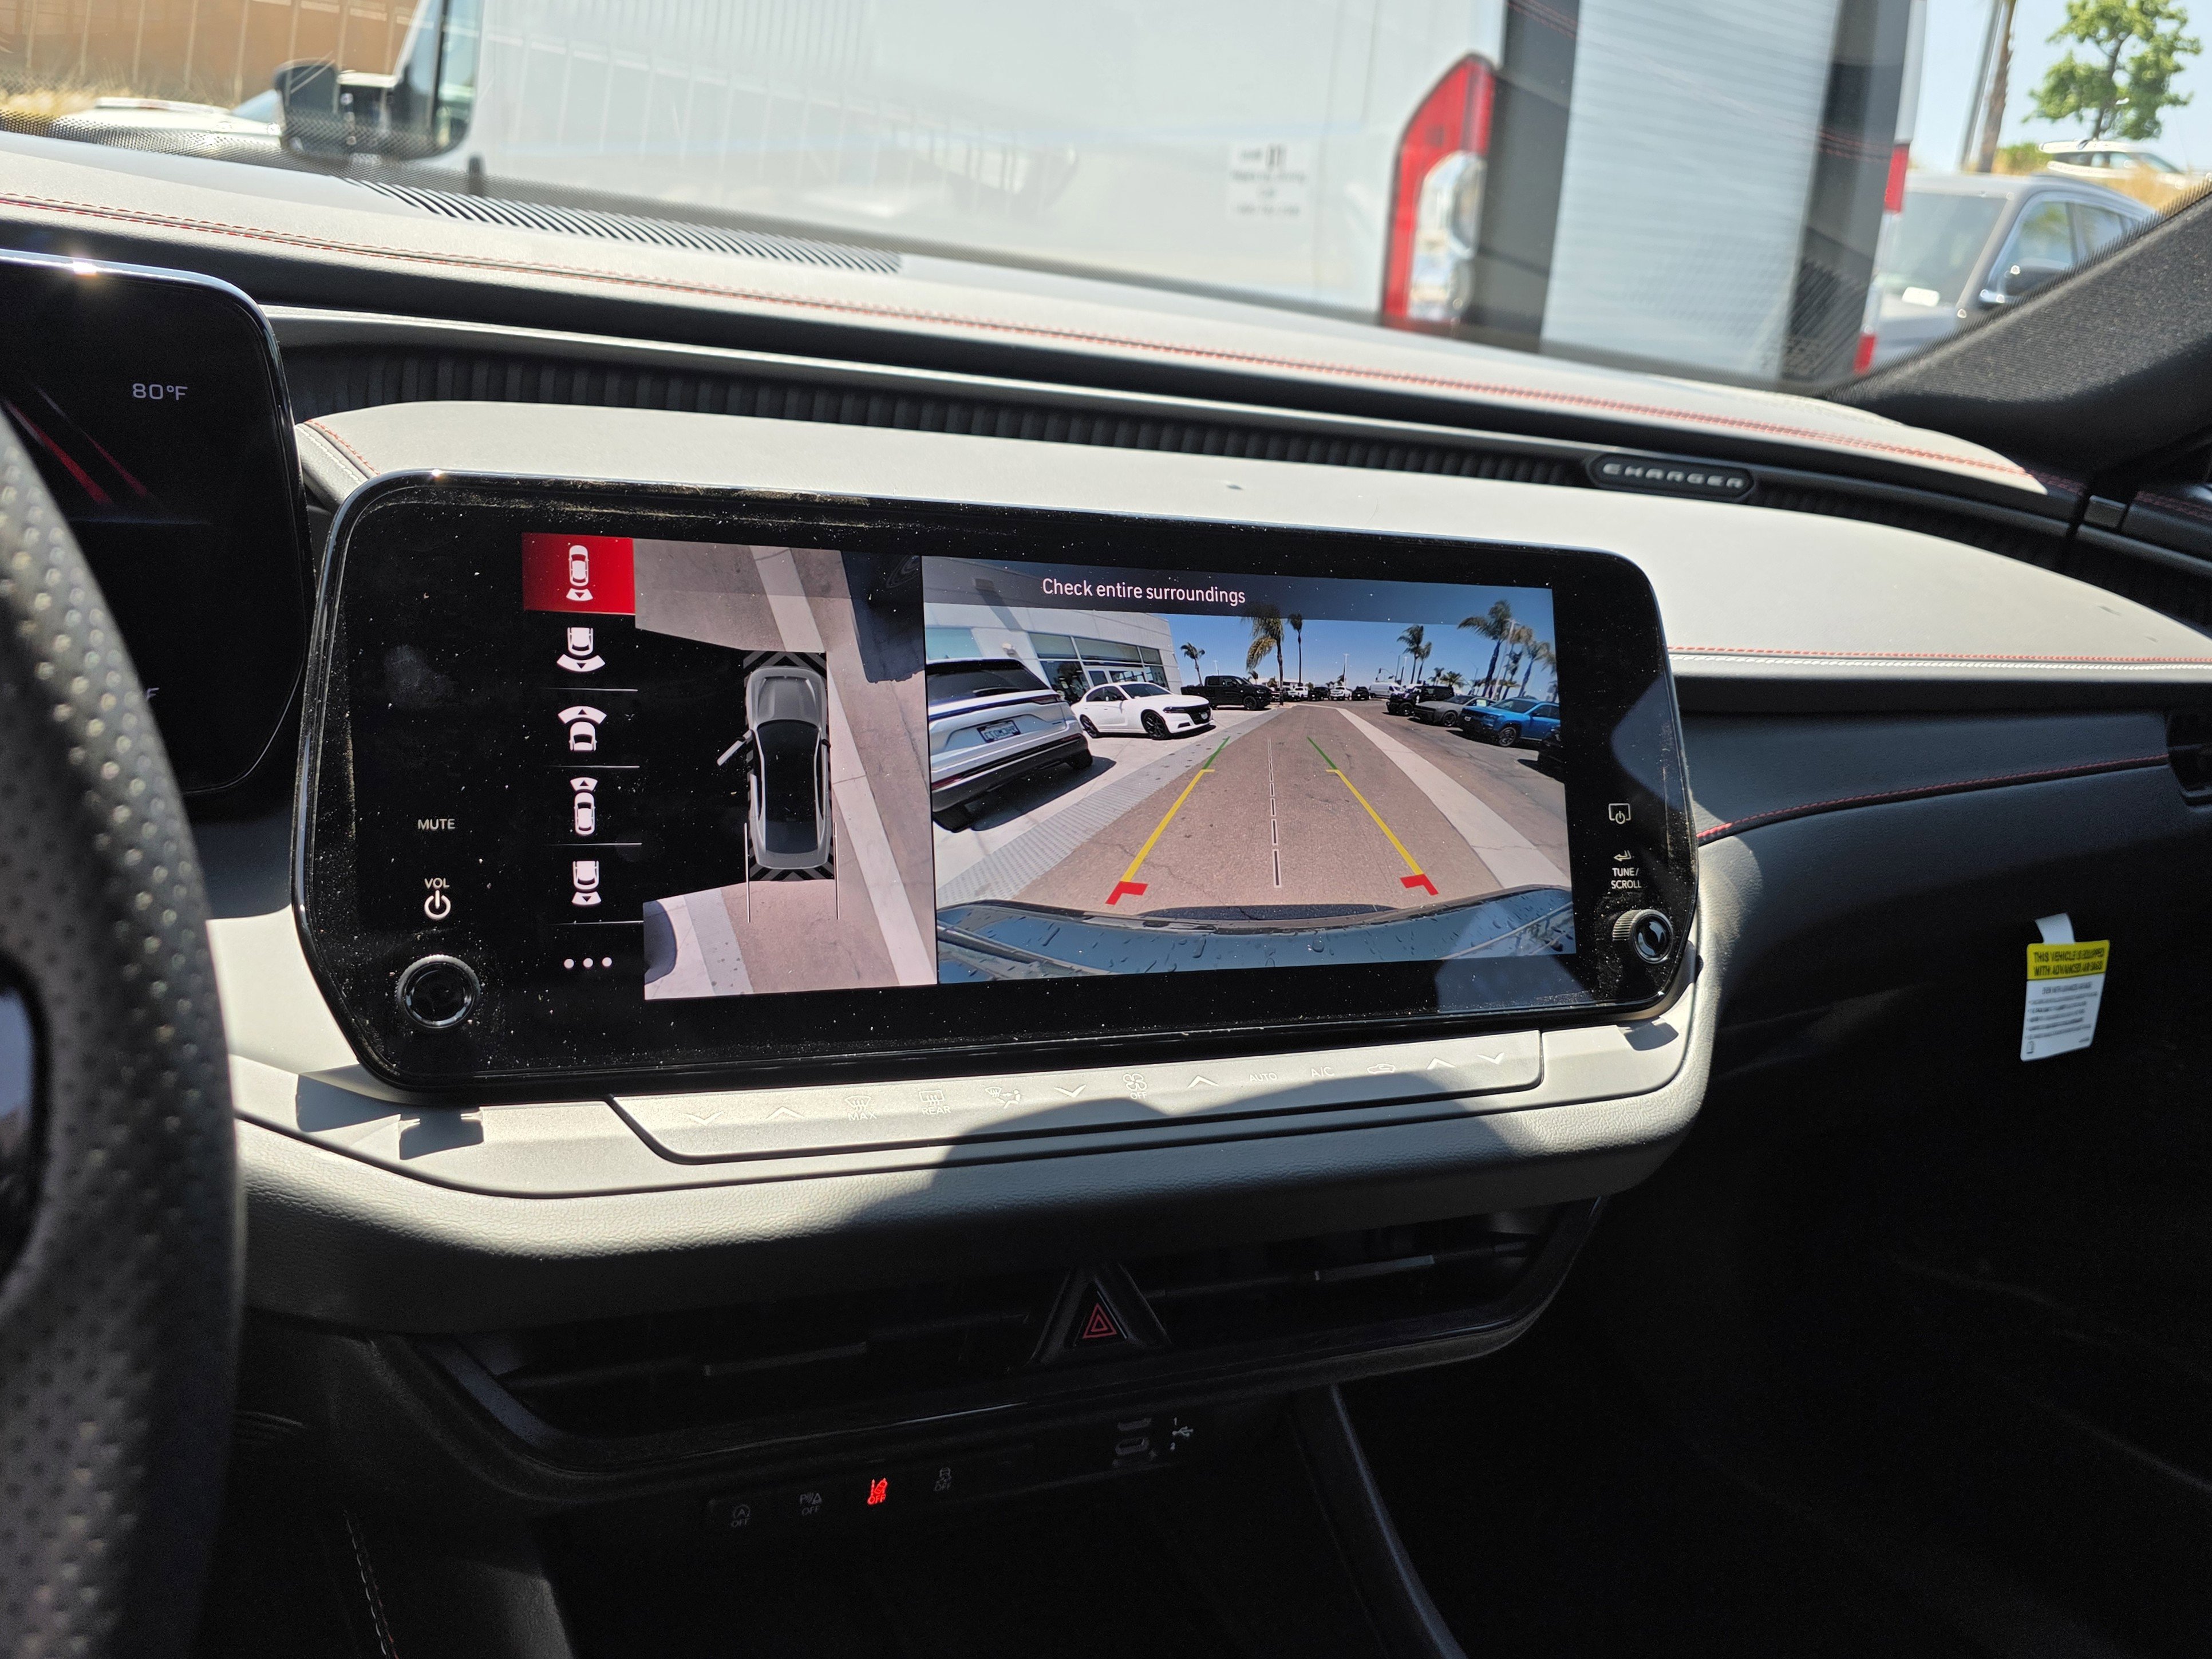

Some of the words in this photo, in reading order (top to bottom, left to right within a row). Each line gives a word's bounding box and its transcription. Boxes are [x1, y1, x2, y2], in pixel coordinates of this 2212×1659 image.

[132, 383, 188, 400] 80°F
[1042, 578, 1093, 597] Check
[1096, 582, 1143, 598] entire
[1146, 586, 1246, 607] surroundings
[417, 819, 456, 830] MUTE
[1611, 867, 1640, 877] TUNE/
[424, 877, 450, 889] VOL
[1610, 879, 1643, 890] SCROLL
[2033, 951, 2049, 963] THIS
[2050, 950, 2075, 962] VEHICLE
[2034, 965, 2051, 977] WITH
[1249, 1072, 1278, 1083] AUTO
[1310, 1066, 1335, 1078] A/C
[1129, 1092, 1148, 1100] OFF
[922, 1105, 951, 1115] REAR
[847, 1111, 878, 1121] MAX
[867, 1494, 886, 1506] OFF
[801, 1506, 820, 1516] OFF
